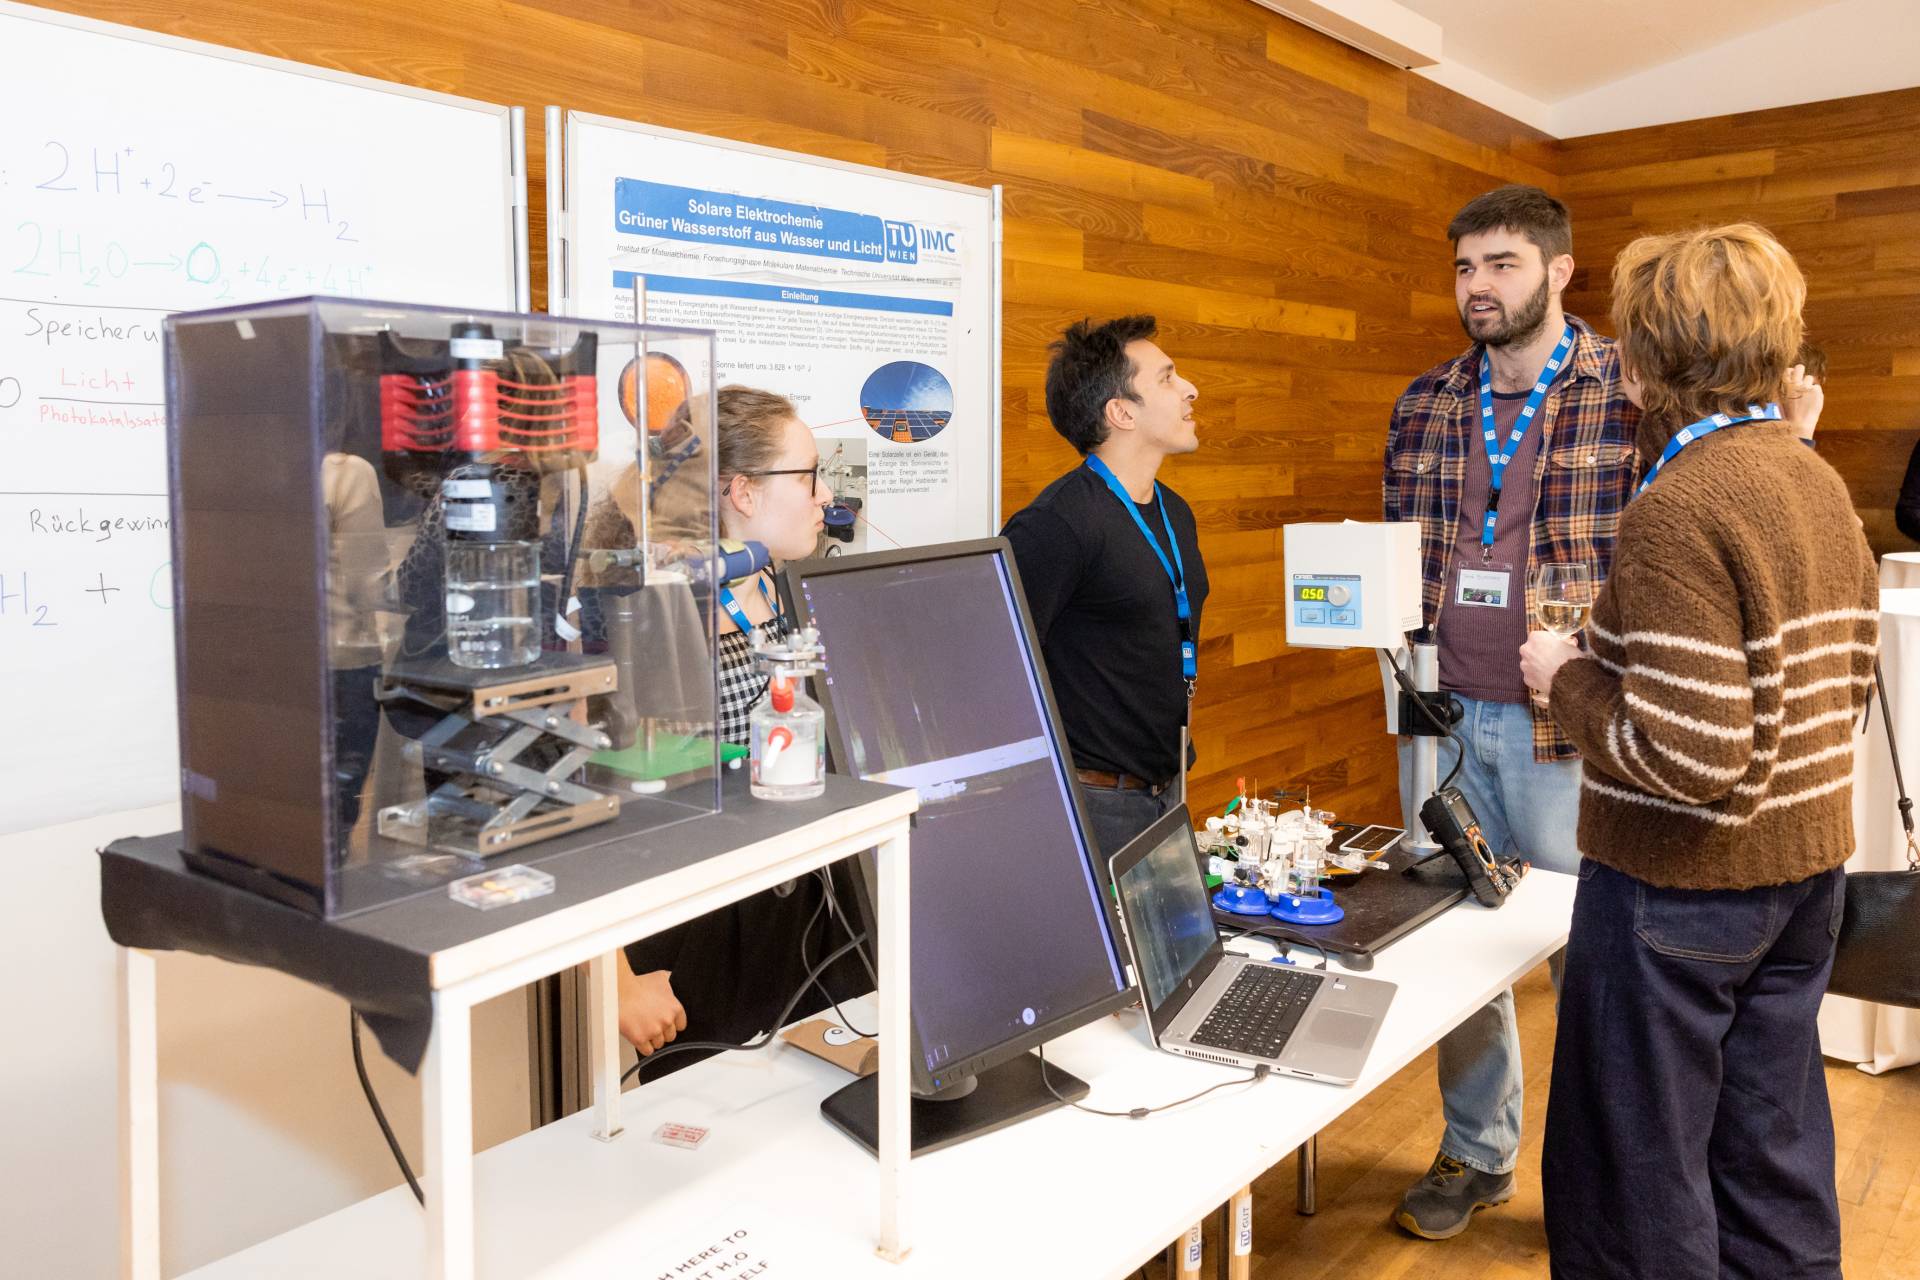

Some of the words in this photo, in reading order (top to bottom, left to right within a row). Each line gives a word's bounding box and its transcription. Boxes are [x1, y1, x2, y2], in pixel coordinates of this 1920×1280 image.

[688, 199, 733, 218] Solare
[736, 204, 823, 230] Elektrochemie
[619, 210, 668, 230] Grüner
[671, 217, 752, 240] Wasserstoff
[754, 231, 777, 243] aus
[780, 231, 824, 249] Wasser
[828, 237, 850, 253] und
[854, 243, 882, 257] Licht
[886, 223, 915, 247] TU
[920, 228, 955, 253] IMC
[616, 244, 640, 254] Institut
[641, 246, 651, 254] für
[703, 253, 763, 267] Forschungsgruppe
[763, 260, 795, 271] Molekulare
[841, 268, 871, 278] Technische
[889, 250, 915, 261] WIEN
[782, 290, 818, 303] Einleitung
[61, 367, 135, 393] Licht
[790, 393, 811, 403] Energie
[675, 1245, 723, 1273] HERE
[722, 1230, 747, 1244] TO
